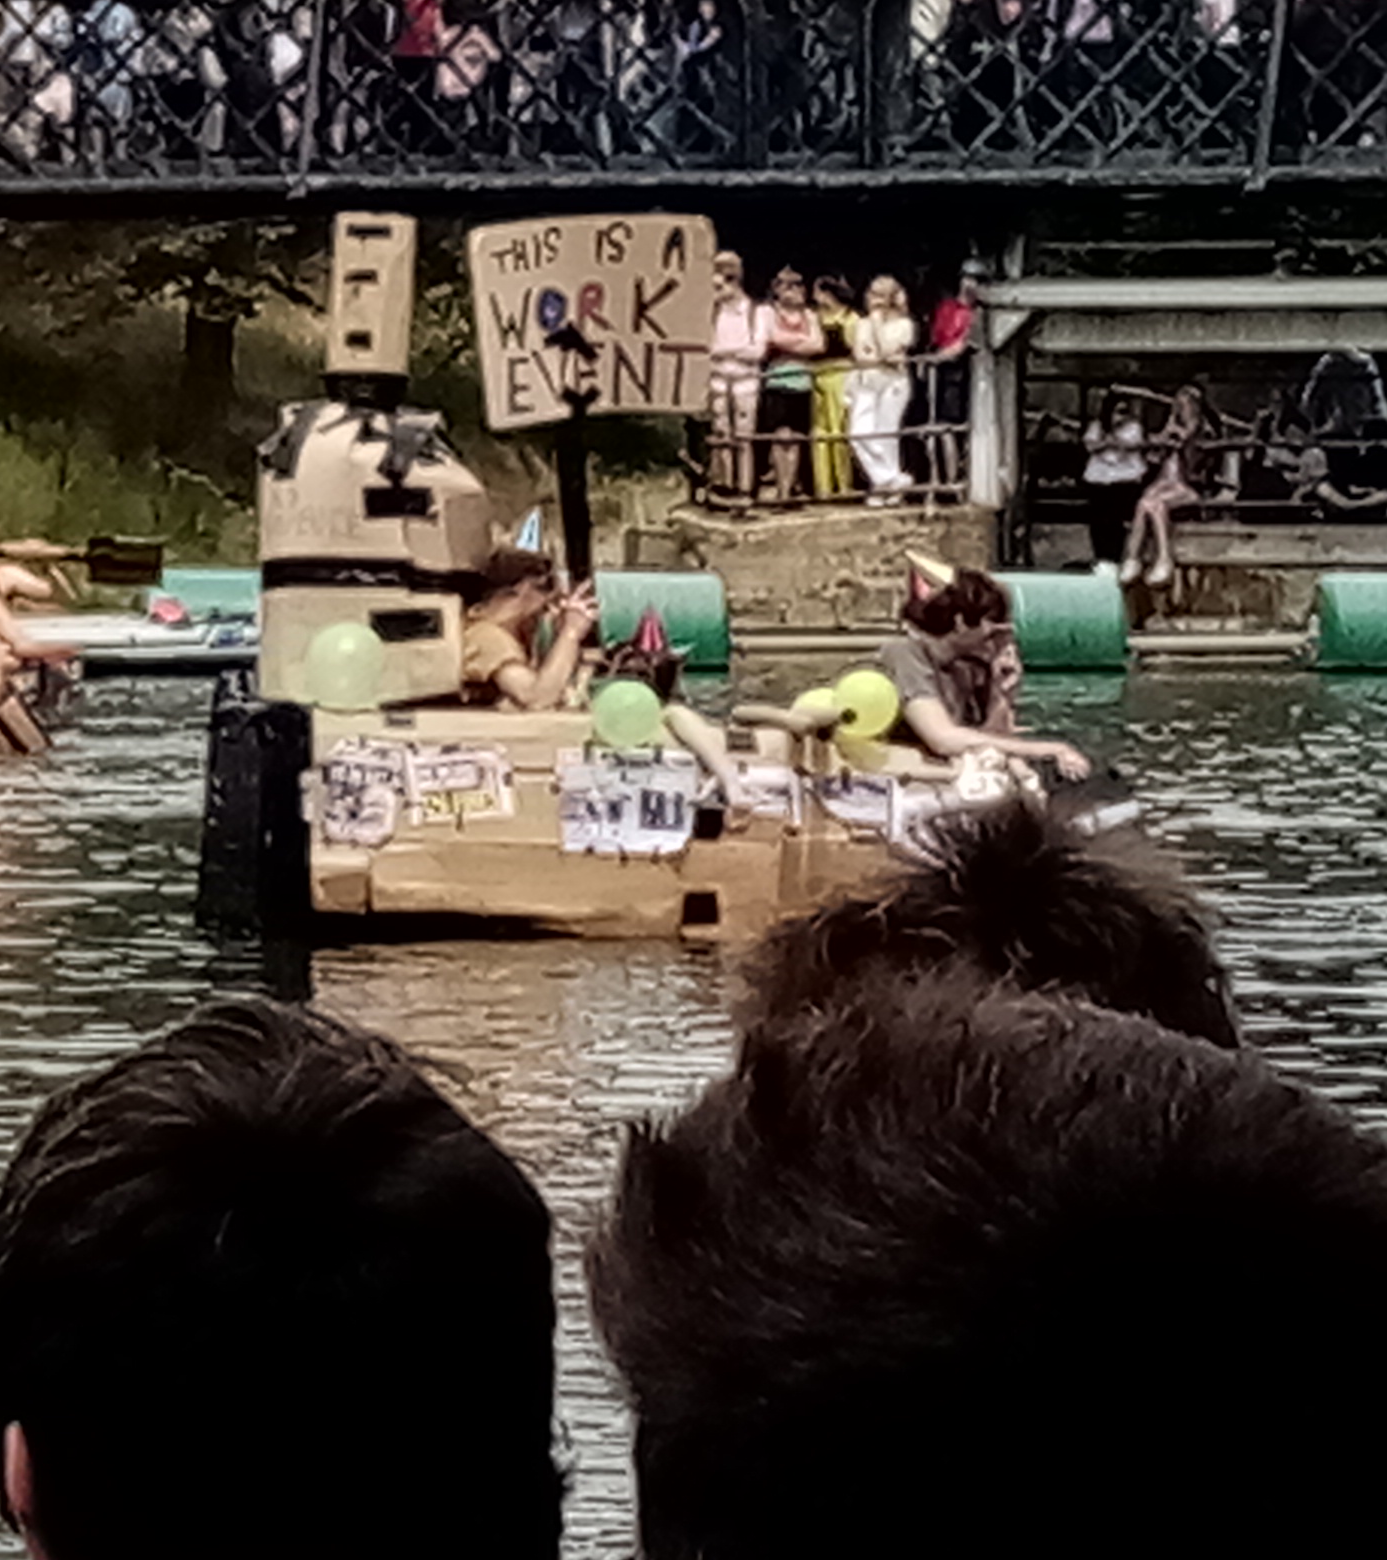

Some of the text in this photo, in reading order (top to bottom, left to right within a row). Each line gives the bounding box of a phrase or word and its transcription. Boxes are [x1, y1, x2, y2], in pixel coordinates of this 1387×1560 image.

[490, 221, 686, 274] THIS IS A
[488, 277, 680, 349] WORK
[506, 341, 710, 415] EVENT
